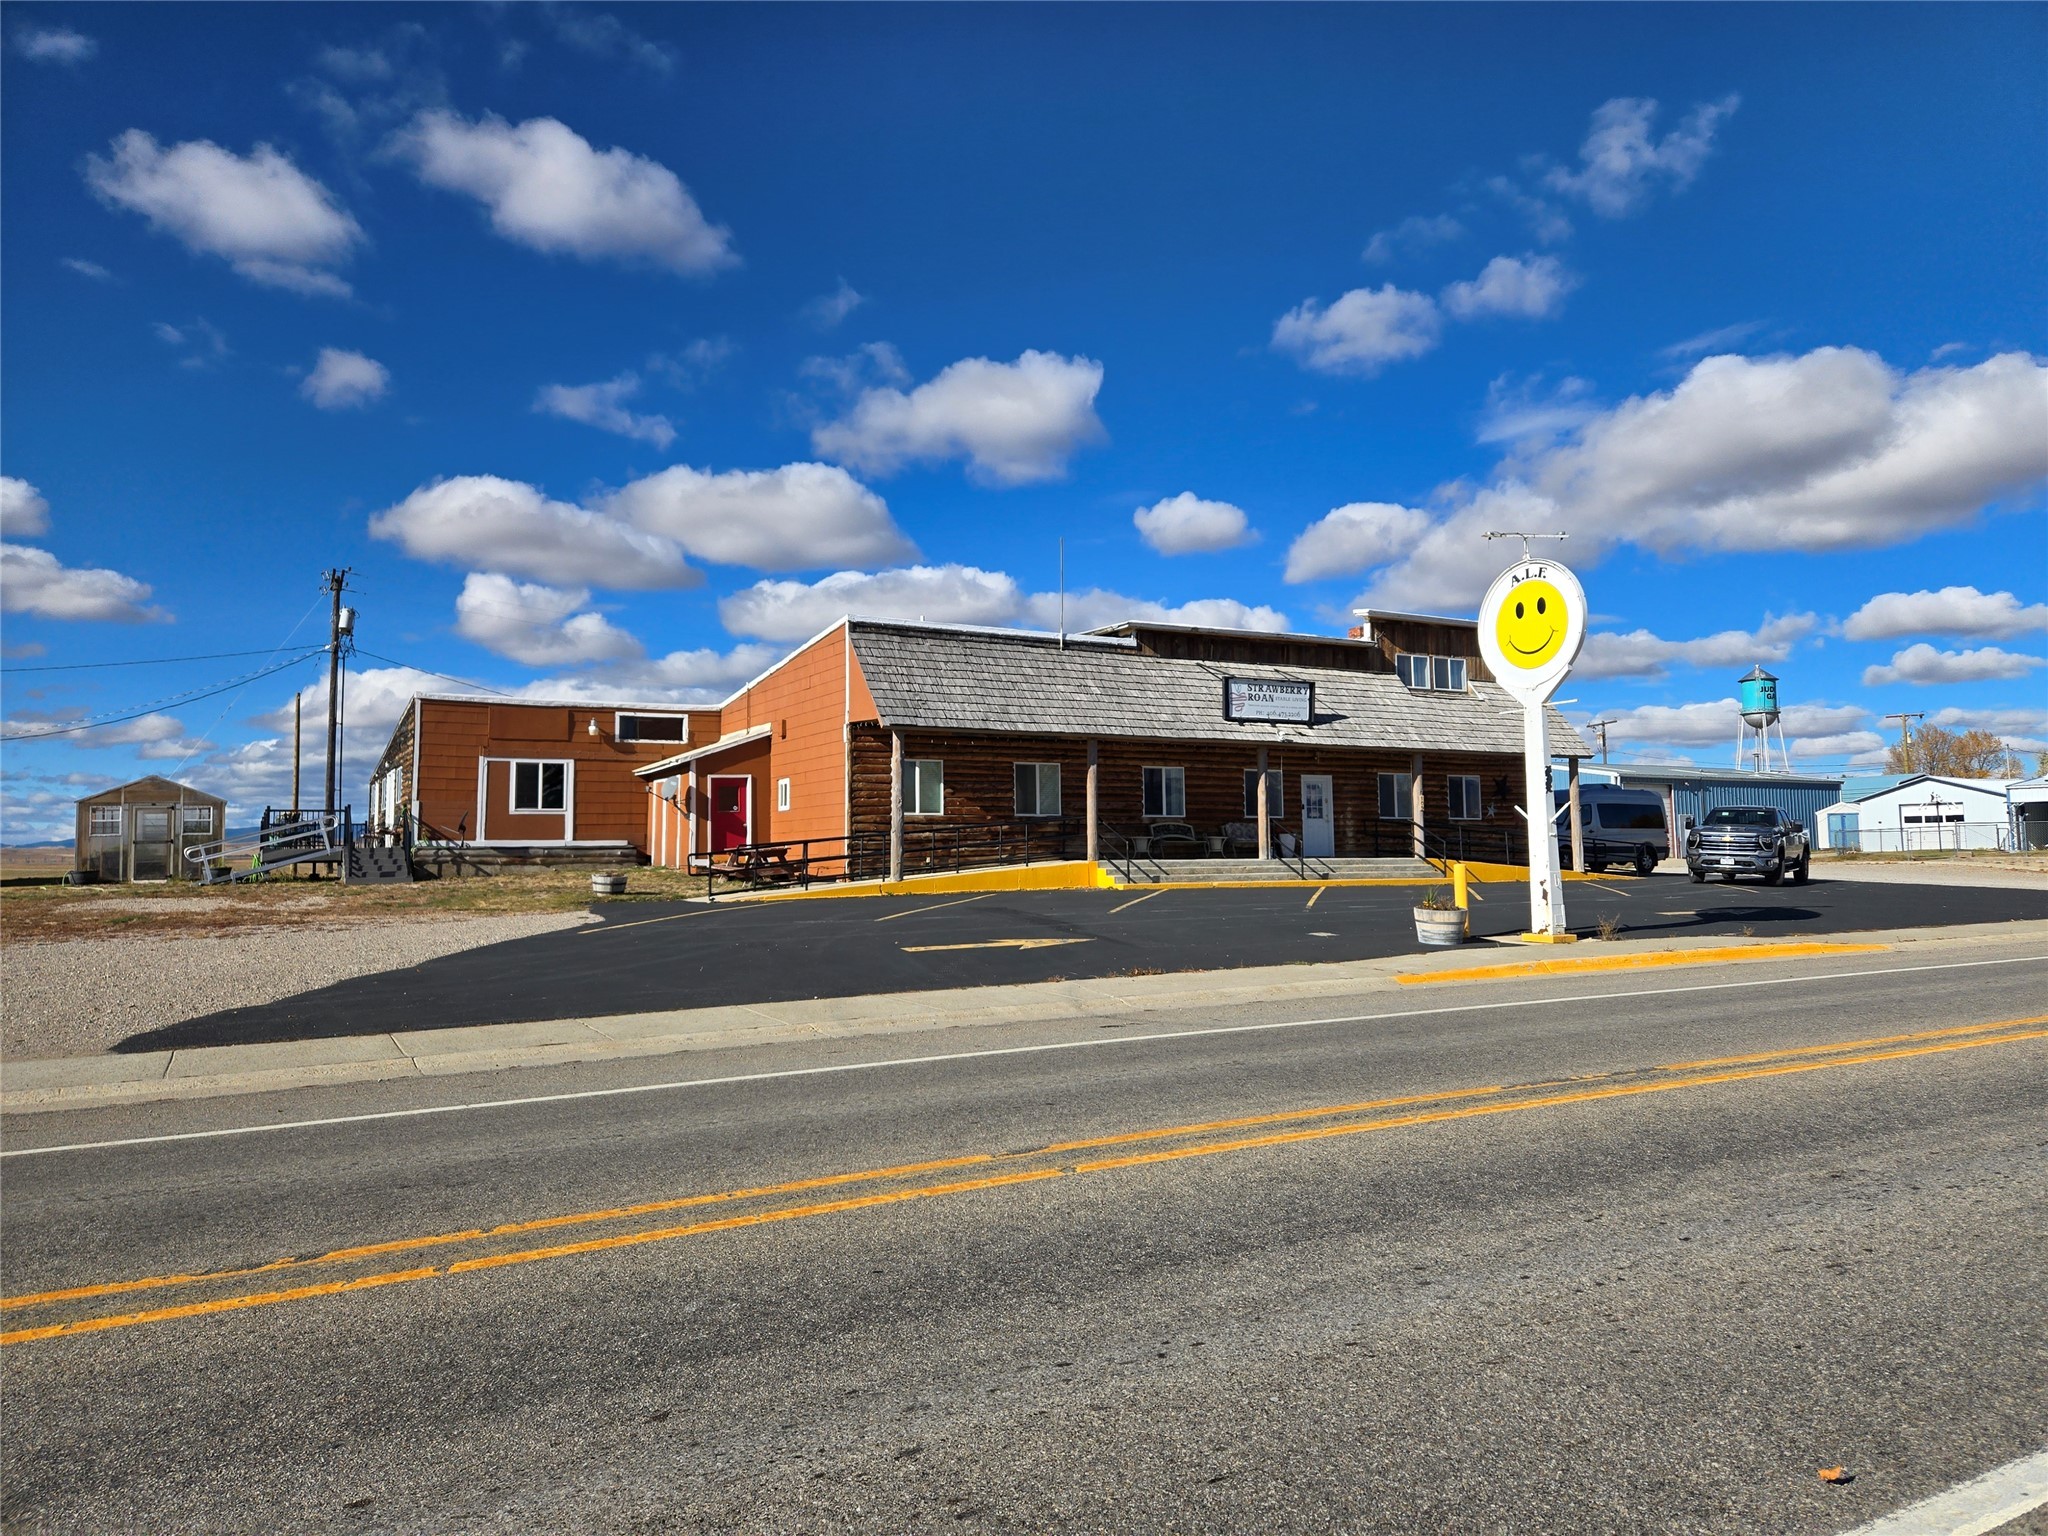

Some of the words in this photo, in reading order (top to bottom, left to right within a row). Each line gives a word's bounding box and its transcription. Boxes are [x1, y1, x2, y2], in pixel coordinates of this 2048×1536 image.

[1511, 567, 1546, 588] A.L.F.
[1247, 684, 1308, 695] STRAWBERRY
[1248, 693, 1274, 702] ROAN
